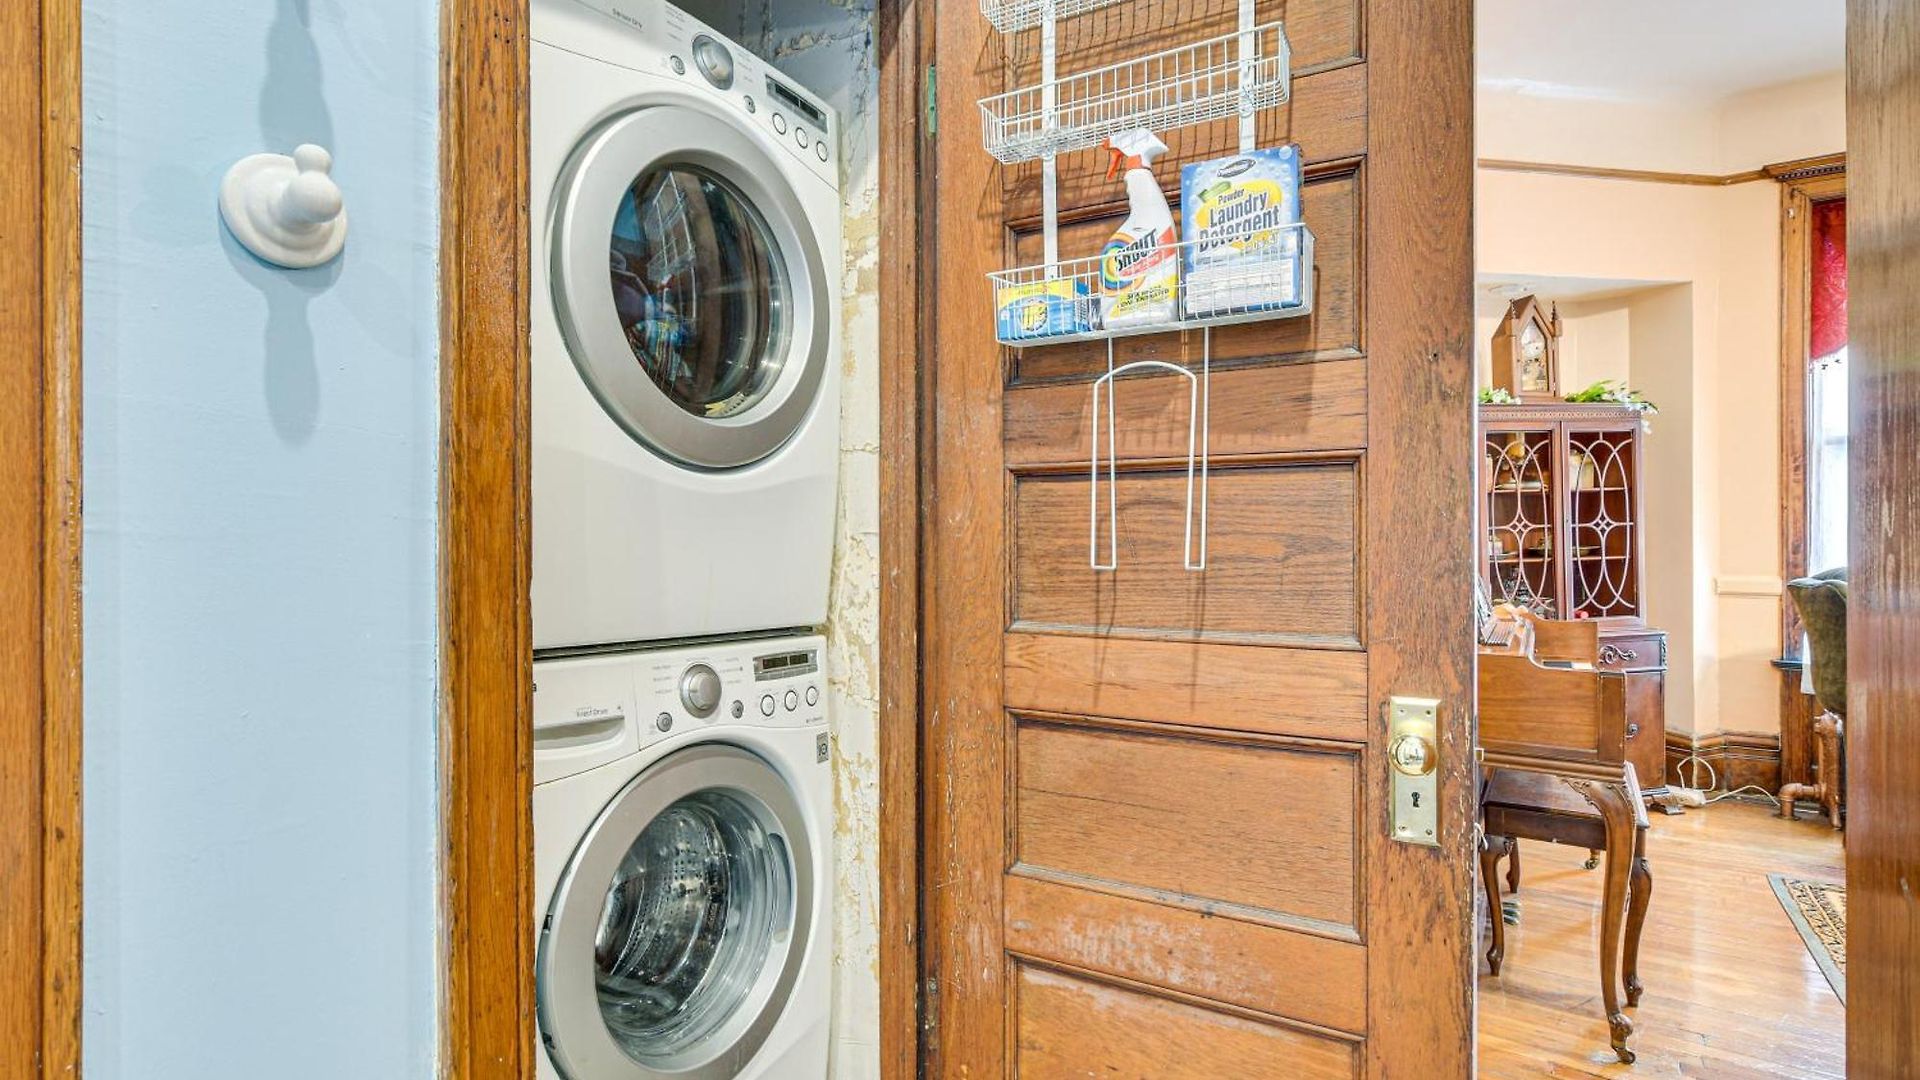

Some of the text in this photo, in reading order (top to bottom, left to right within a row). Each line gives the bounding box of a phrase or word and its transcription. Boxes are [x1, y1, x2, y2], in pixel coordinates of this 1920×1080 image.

[1210, 192, 1267, 228] Laundry
[1218, 188, 1245, 205] Powder
[1199, 205, 1280, 253] Detergent
